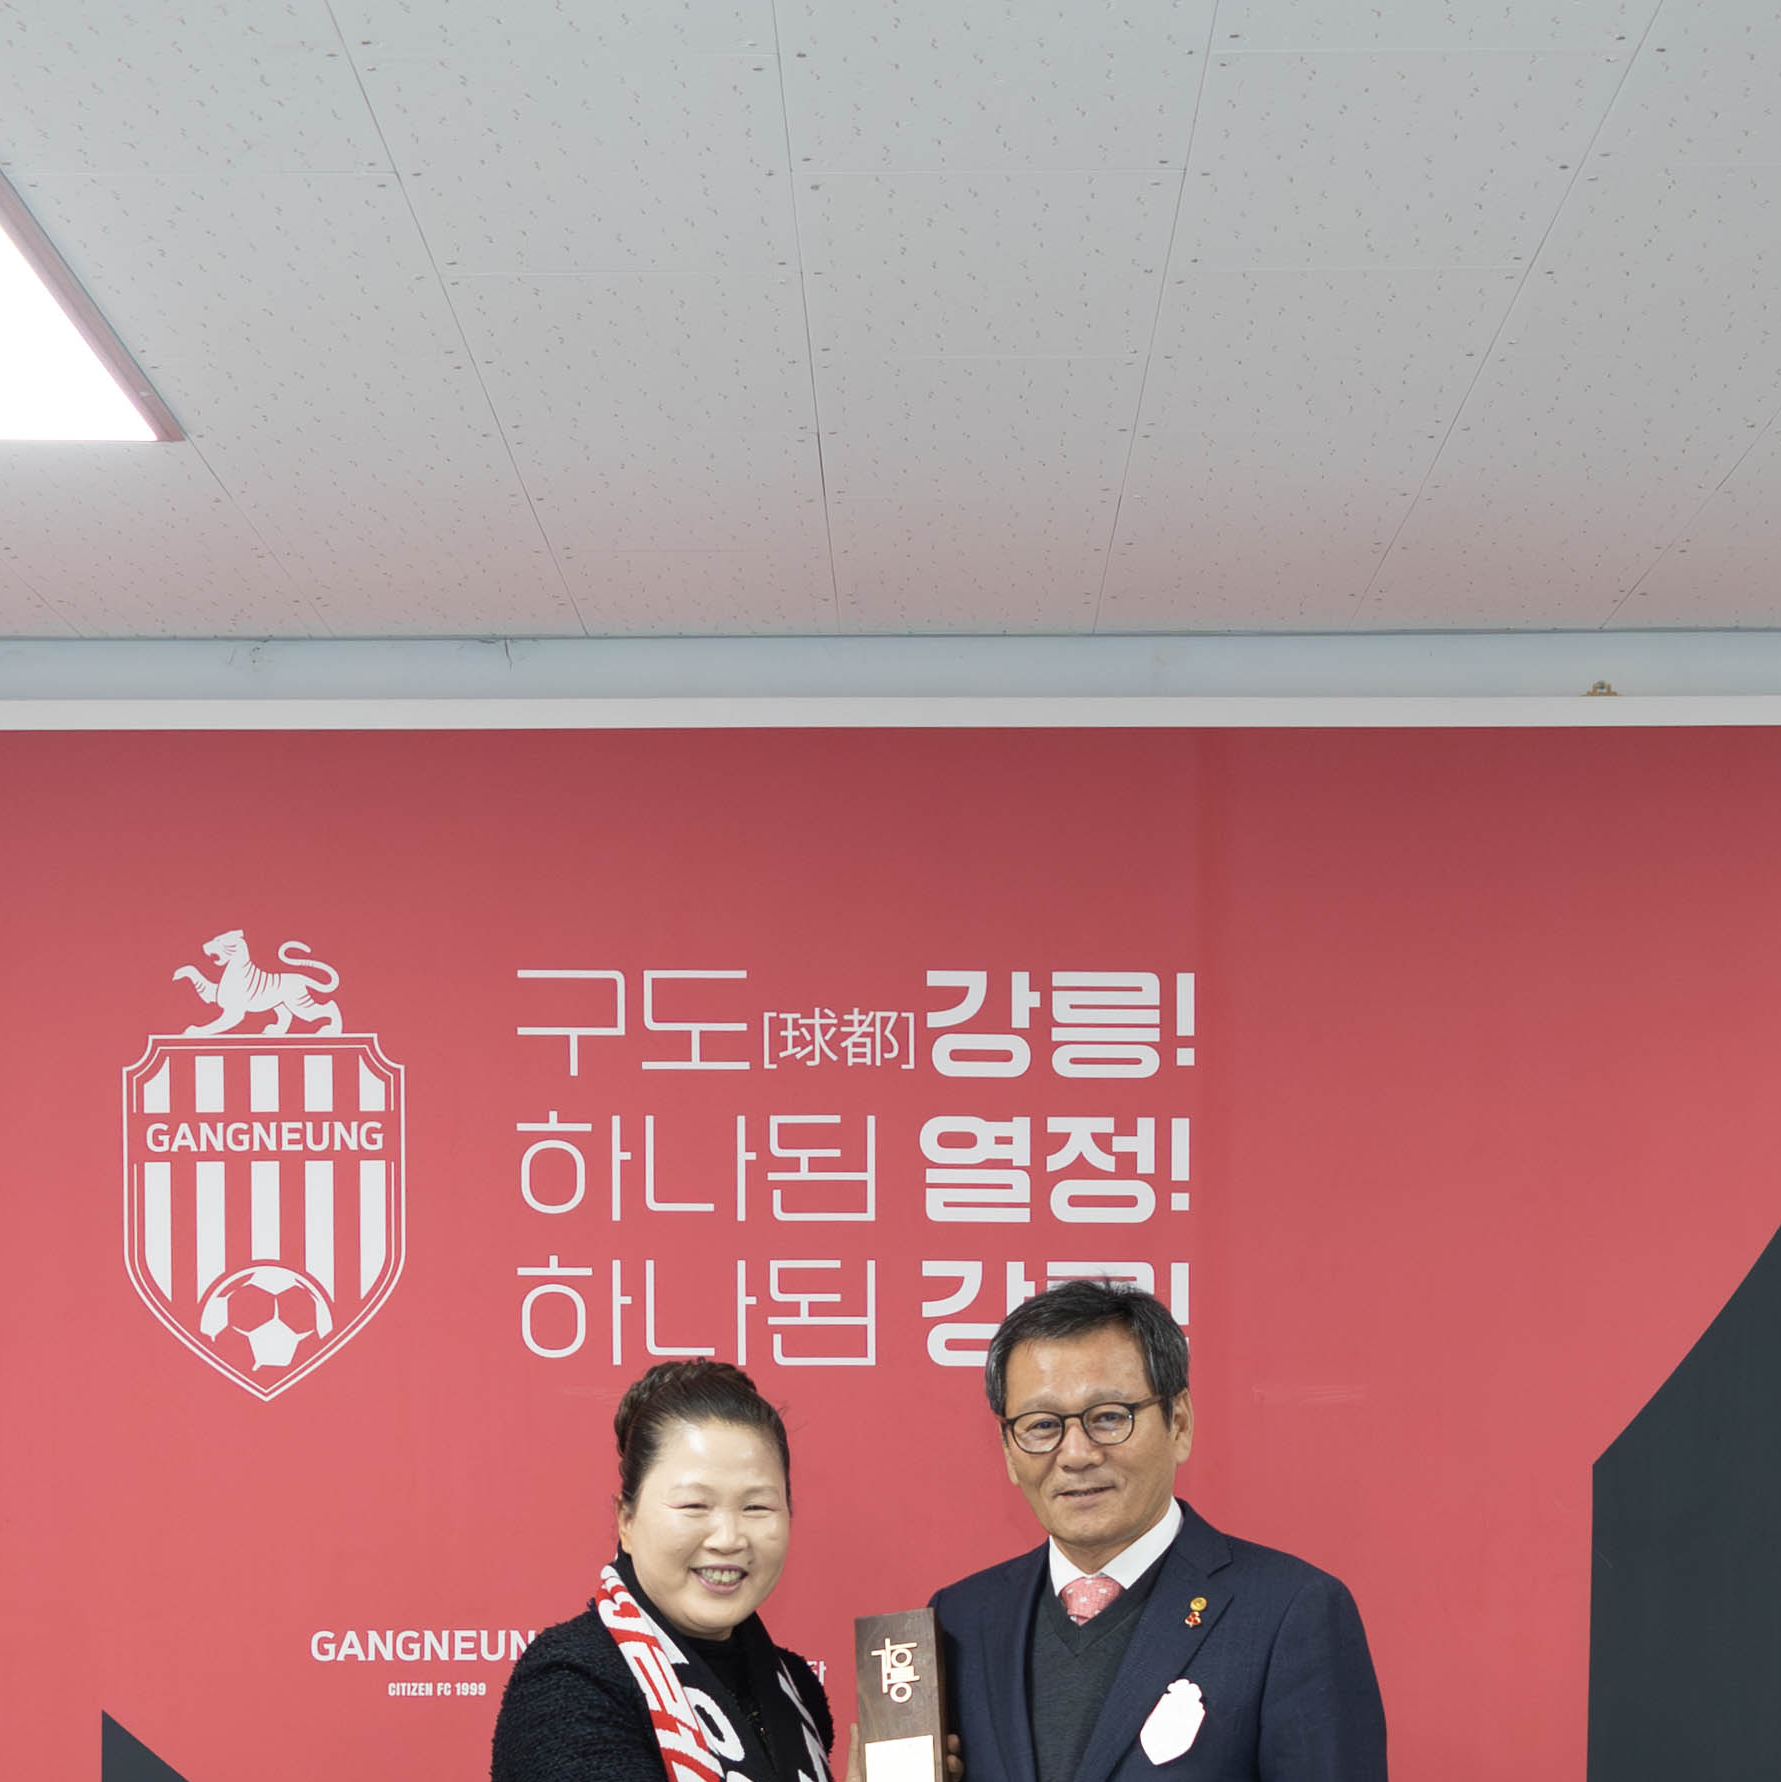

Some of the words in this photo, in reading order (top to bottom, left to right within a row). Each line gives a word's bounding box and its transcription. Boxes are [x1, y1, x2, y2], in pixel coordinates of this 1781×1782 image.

[143, 1121, 385, 1153] GANGNEUNG
[516, 1110, 876, 1222] 하나된
[919, 1115, 1190, 1224] 열정!
[516, 1255, 876, 1366] 하나된
[310, 1629, 538, 1662] GANGNEUN
[387, 1681, 434, 1697] CITIZEN
[436, 1681, 452, 1697] FC
[454, 1681, 487, 1697] 1999
